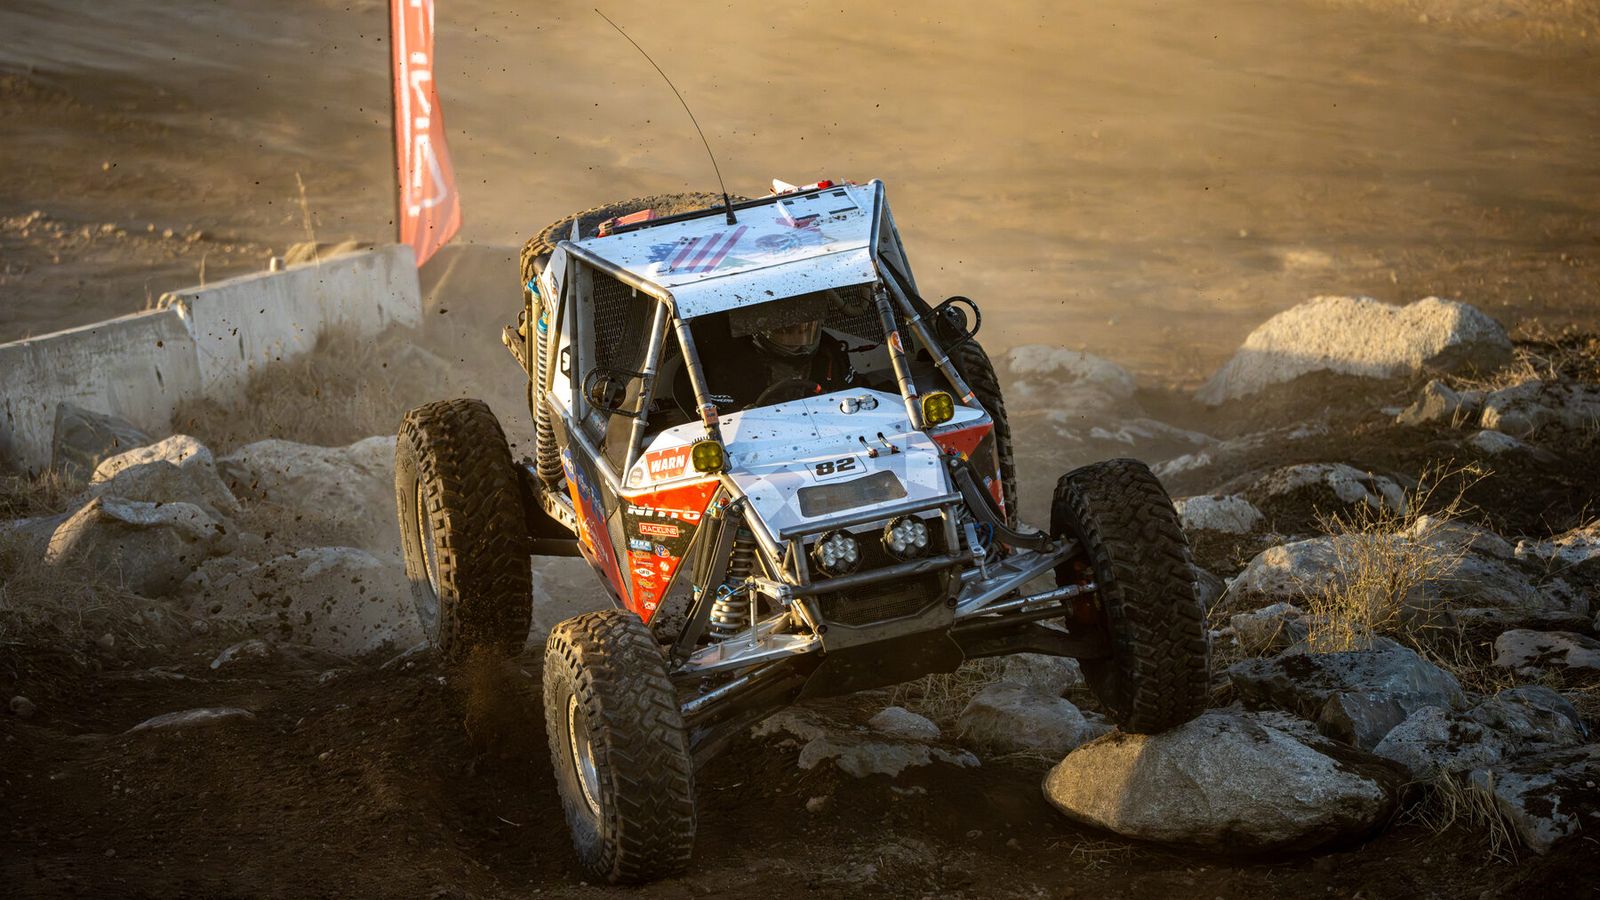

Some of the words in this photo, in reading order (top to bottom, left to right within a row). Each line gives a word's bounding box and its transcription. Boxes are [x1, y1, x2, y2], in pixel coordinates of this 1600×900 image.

[651, 454, 686, 473] WARN
[816, 457, 856, 476] 82
[627, 504, 701, 520] NITTO
[641, 525, 677, 536] RACELINE
